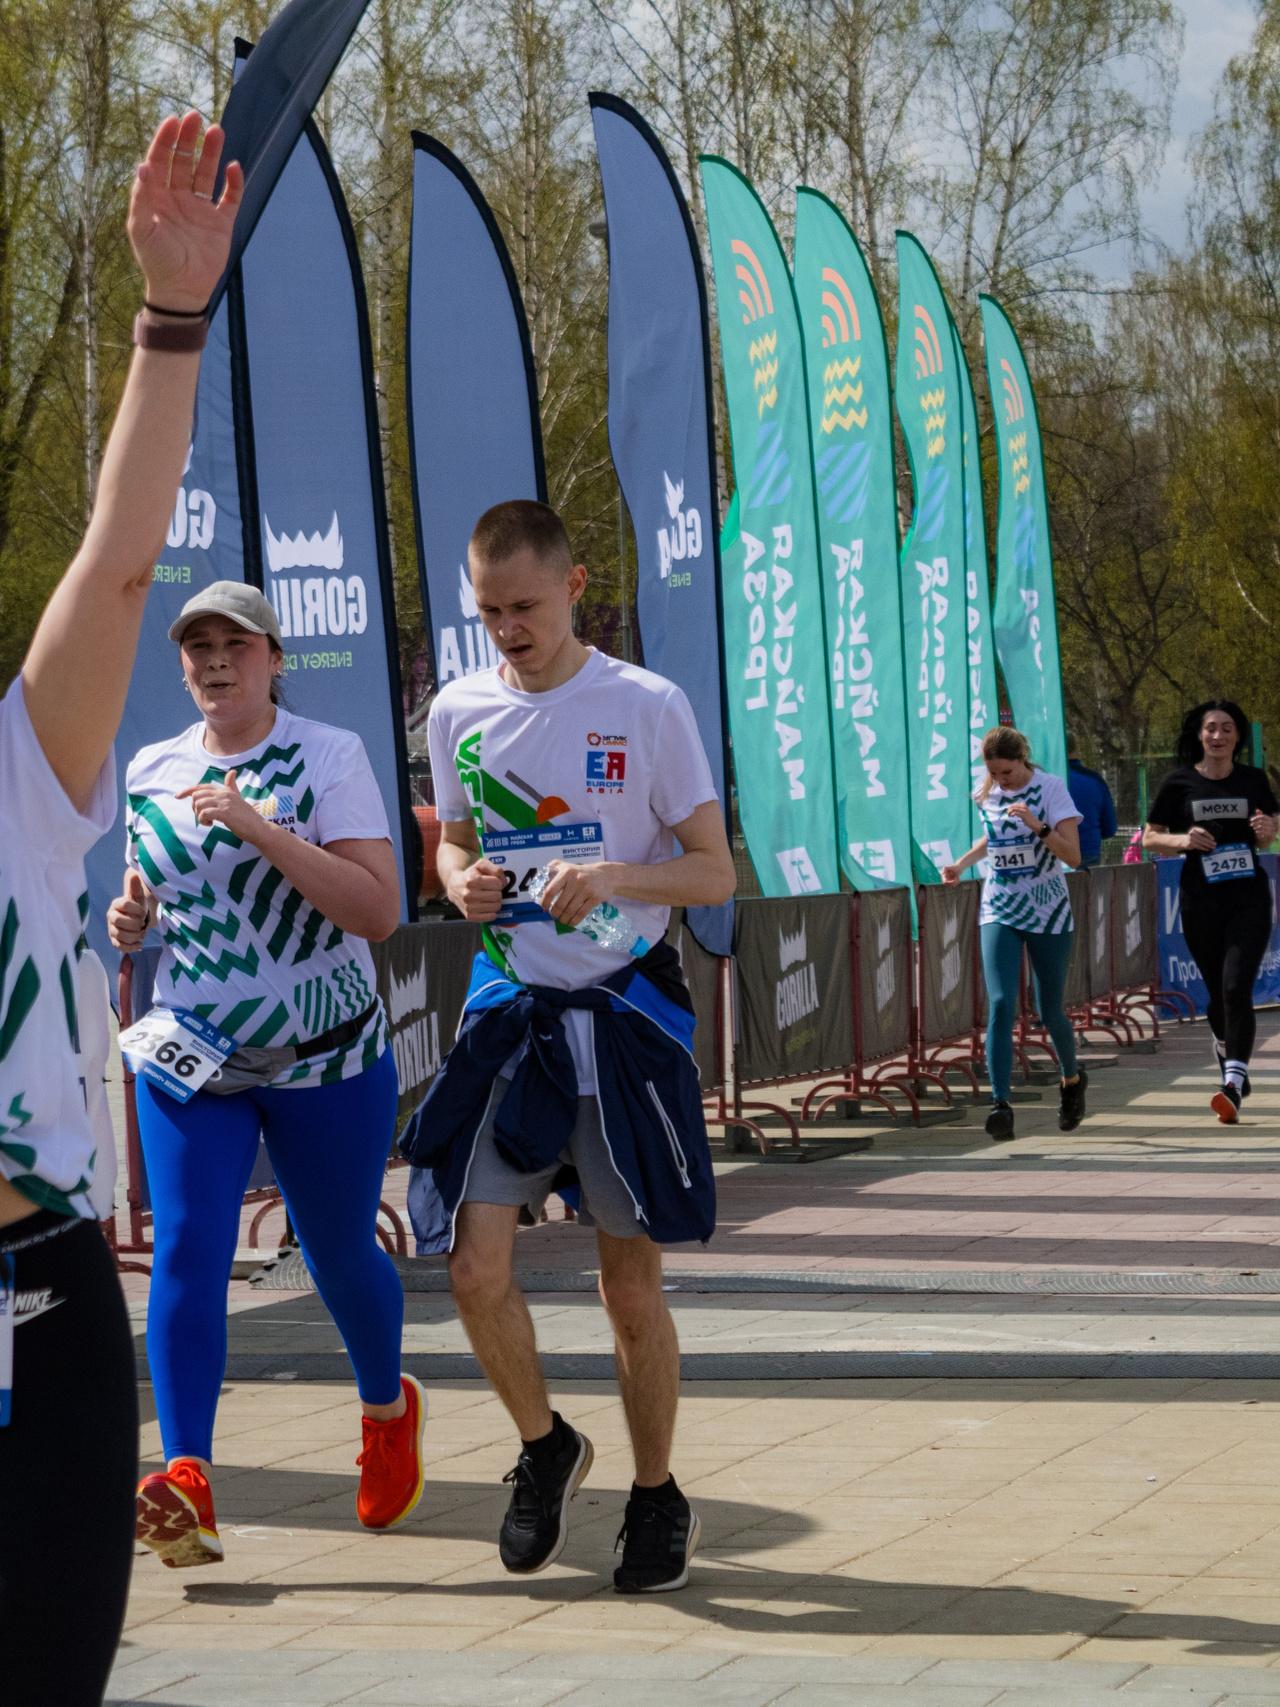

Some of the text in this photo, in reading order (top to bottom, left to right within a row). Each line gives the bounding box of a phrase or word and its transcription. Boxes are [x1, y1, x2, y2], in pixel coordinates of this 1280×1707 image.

[562, 846, 600, 855] ВИКТОРИЯ
[994, 853, 1025, 868] 2141
[1211, 857, 1248, 874] 2478
[776, 962, 820, 1031] GORILLA
[123, 1031, 202, 1078] 2366
[393, 1011, 442, 1096] ORILLA
[15, 1289, 53, 1312] NIKE
